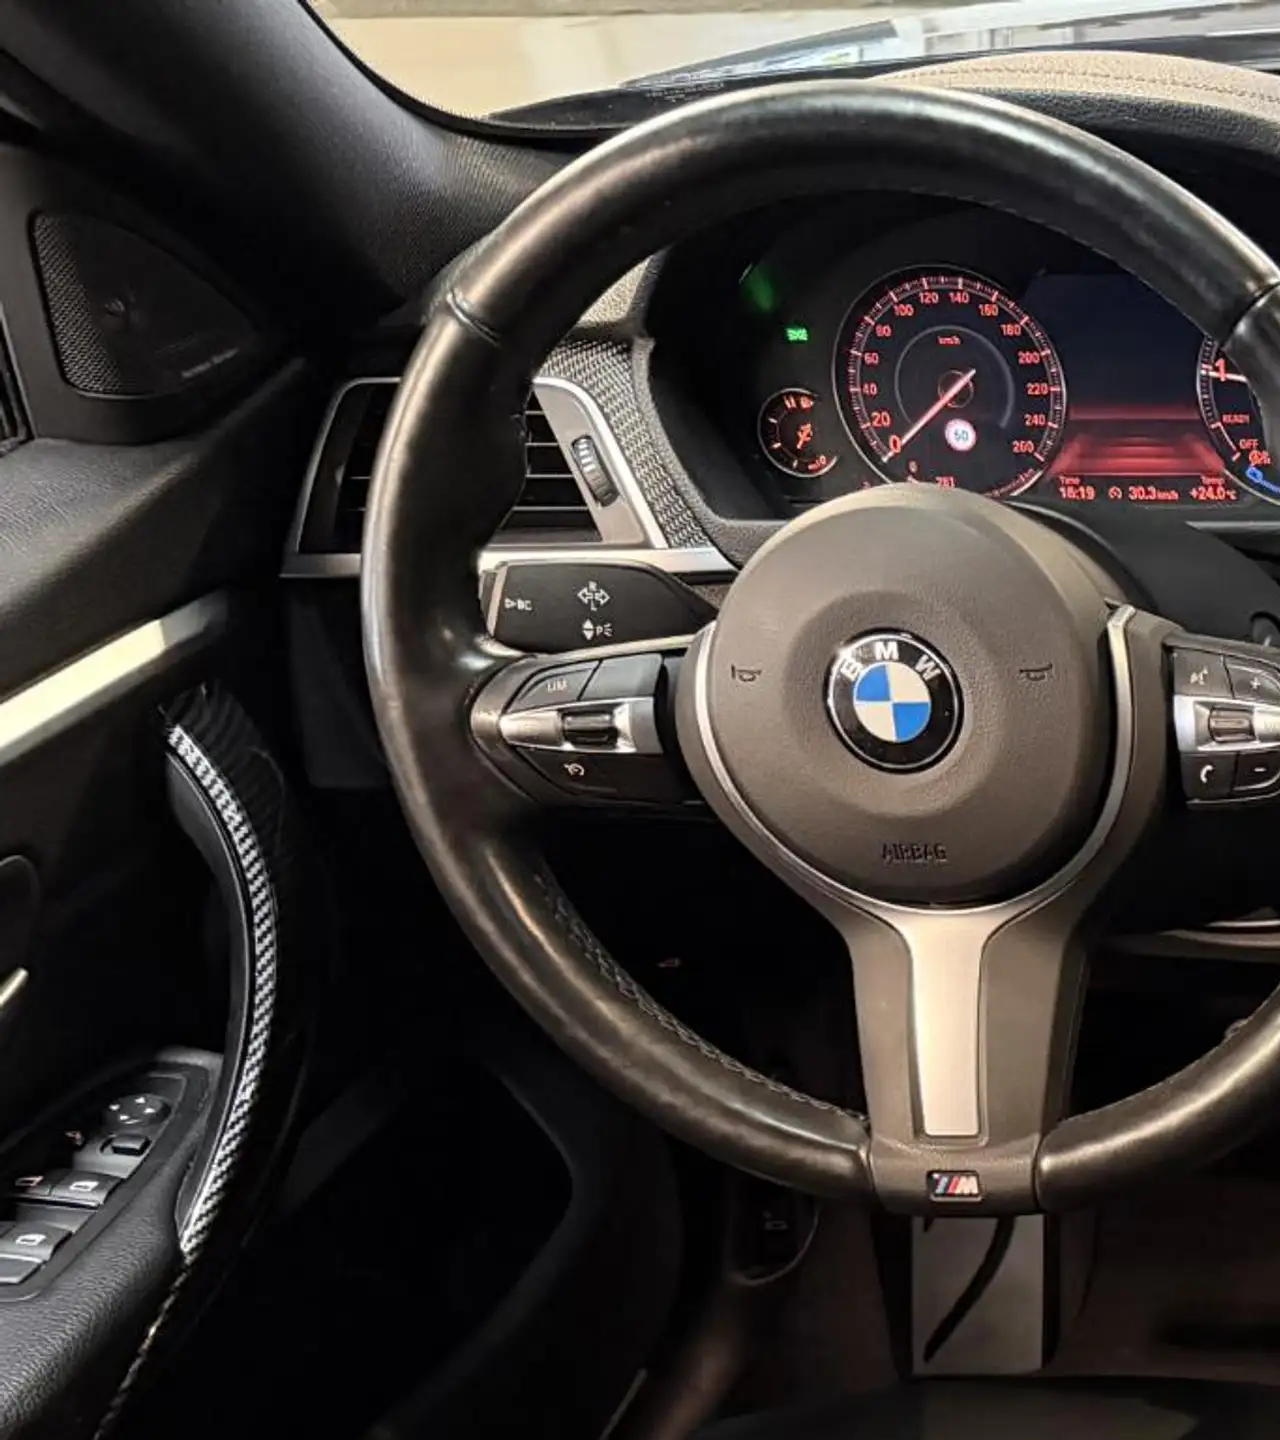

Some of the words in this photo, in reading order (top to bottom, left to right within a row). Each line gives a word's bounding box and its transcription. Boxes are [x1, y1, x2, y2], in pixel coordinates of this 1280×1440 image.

[919, 291, 938, 304] 120
[949, 292, 969, 304] 140
[893, 304, 914, 317] 100
[978, 304, 998, 317] 160
[875, 324, 891, 337] 80
[1001, 323, 1021, 337] 180
[864, 352, 879, 365] 60
[1018, 351, 1040, 365] 200
[862, 383, 878, 396] 40
[1027, 383, 1048, 396] 220
[871, 411, 891, 427] 20
[1024, 413, 1046, 426] 240
[889, 434, 901, 454] 0
[1012, 440, 1034, 453] 260
[1239, 438, 1260, 449] OFF
[840, 640, 942, 683] BMW
[881, 842, 948, 863] AIRBAG
